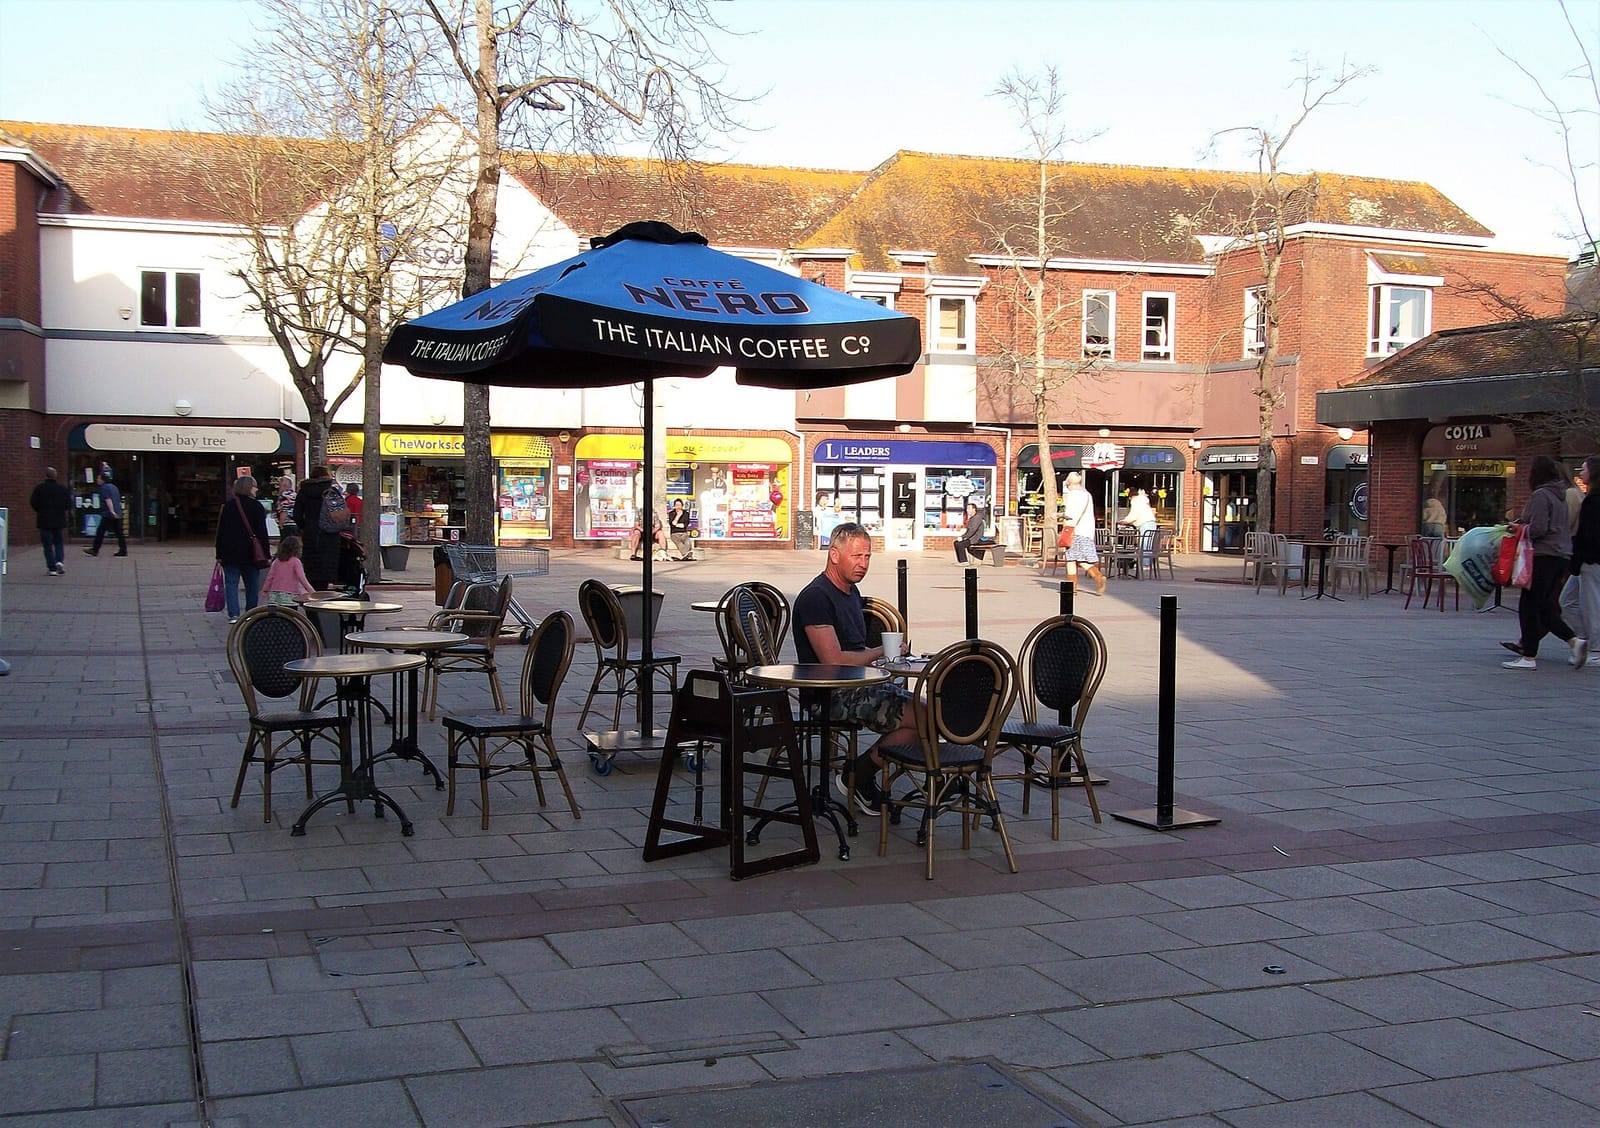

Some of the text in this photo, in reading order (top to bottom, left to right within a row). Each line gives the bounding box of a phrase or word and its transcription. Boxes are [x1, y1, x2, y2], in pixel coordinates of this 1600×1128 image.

[621, 281, 811, 316] NERO
[592, 318, 638, 345] THE
[645, 328, 733, 356] ITALIAN
[739, 337, 830, 359] COFFEE
[411, 339, 436, 359] THE
[431, 342, 475, 362] ITALIAN
[1444, 425, 1484, 440] COSTA
[152, 433, 226, 449] the bay tree
[826, 443, 840, 460] L
[844, 447, 891, 457] LEADERS
[897, 483, 911, 498] L
